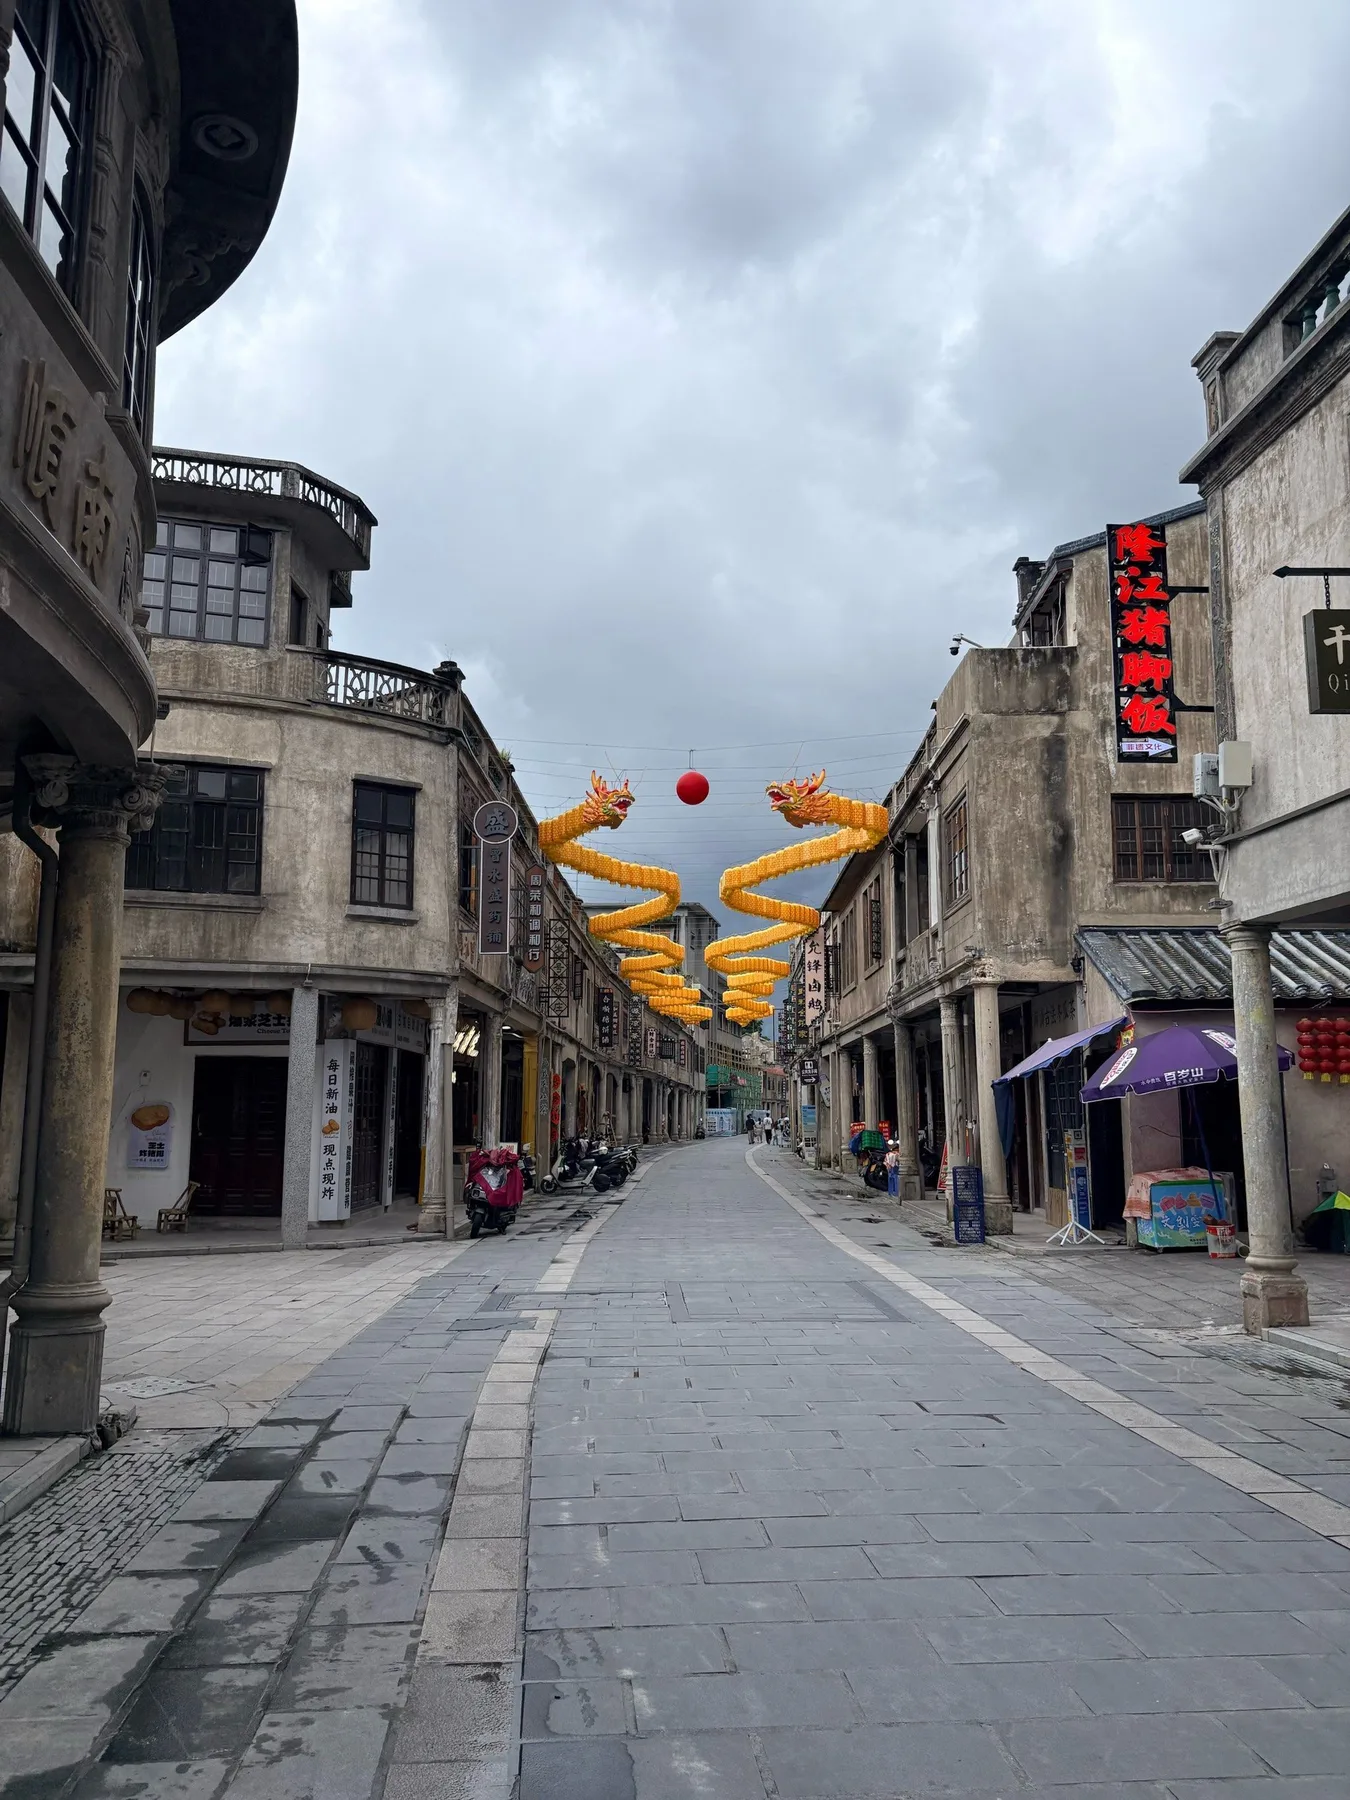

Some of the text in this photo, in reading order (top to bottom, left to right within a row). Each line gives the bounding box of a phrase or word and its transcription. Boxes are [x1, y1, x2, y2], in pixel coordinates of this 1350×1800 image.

[1114, 522, 1176, 735] 隆江猪脚饭
[1126, 743, 1162, 752] 非遗文化
[484, 806, 510, 838] 盛
[807, 940, 823, 1013] 允锋卤鹅
[229, 1013, 291, 1027] 爆浆芝士
[1164, 1067, 1204, 1082] 百岁山
[322, 1058, 341, 1201] 每日新油 现点现炸
